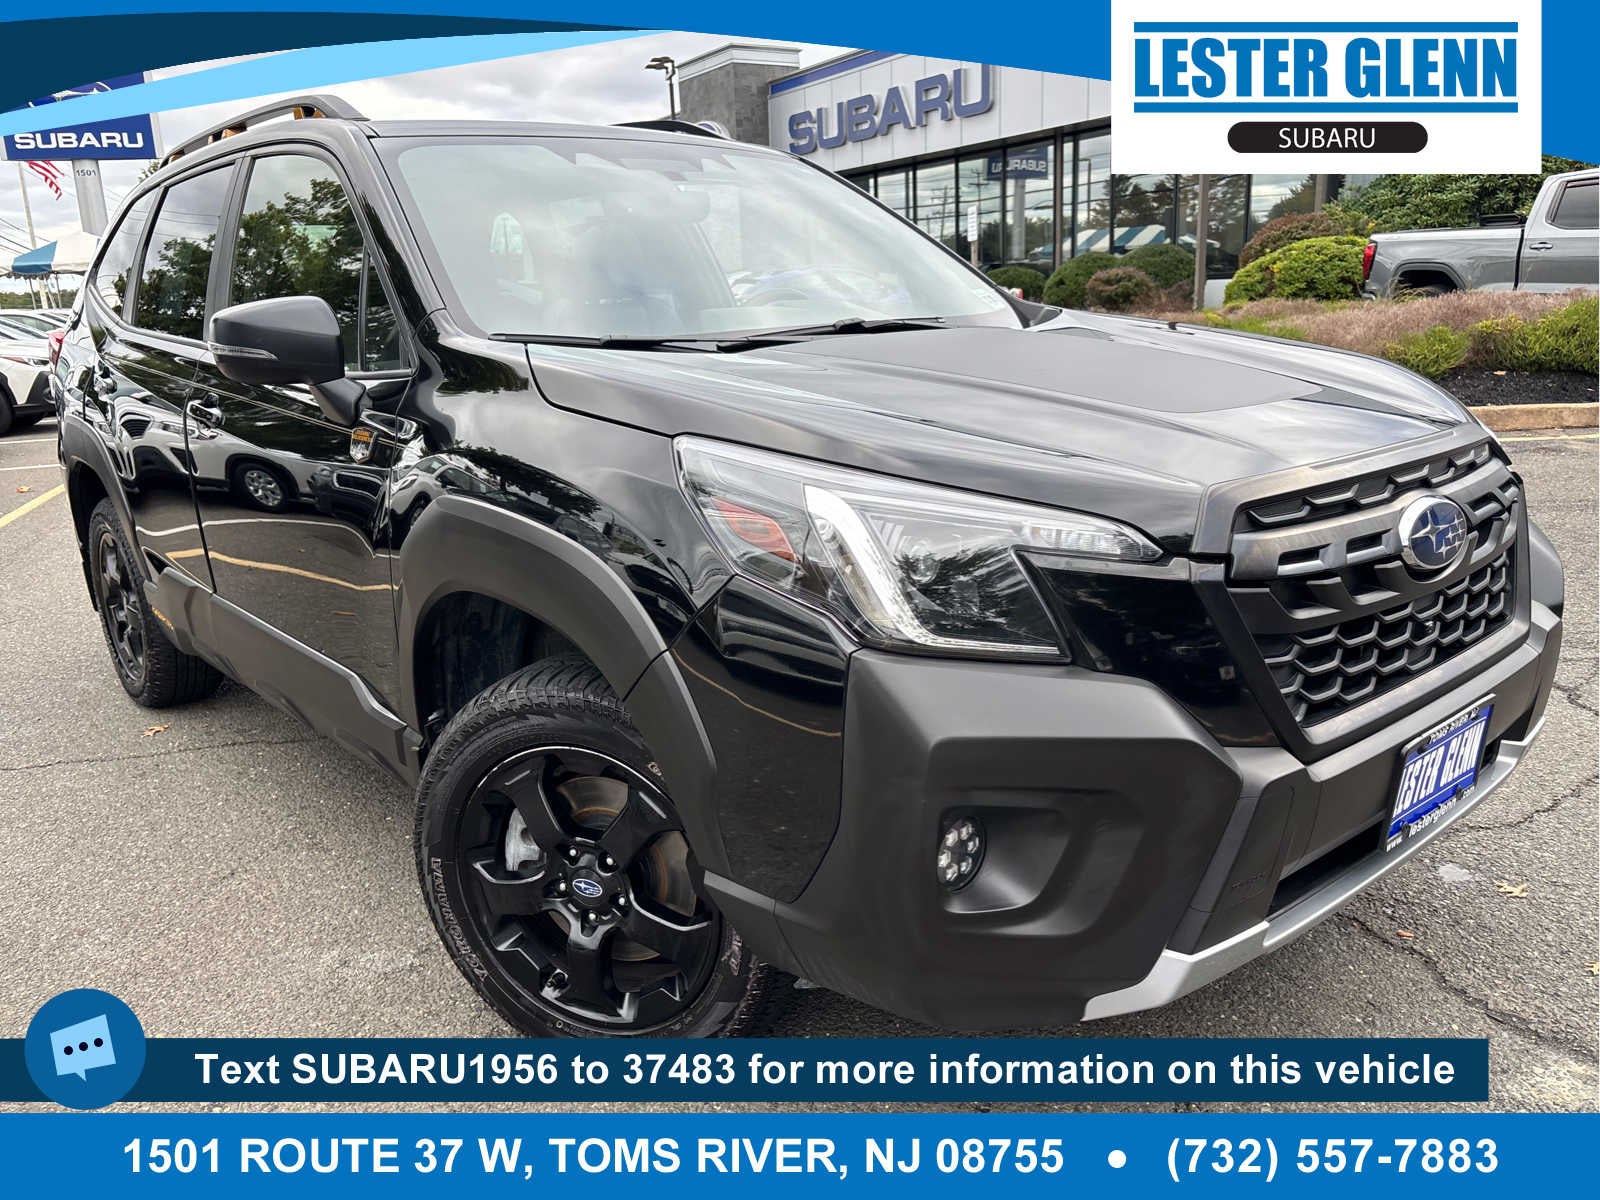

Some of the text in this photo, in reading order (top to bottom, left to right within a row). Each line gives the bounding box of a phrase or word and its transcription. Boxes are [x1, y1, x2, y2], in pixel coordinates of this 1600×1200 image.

[788, 64, 994, 156] SUBARU
[14, 132, 144, 149] SUBARU
[76, 169, 96, 177] 1501
[1393, 720, 1486, 817] LESTER GLENN
